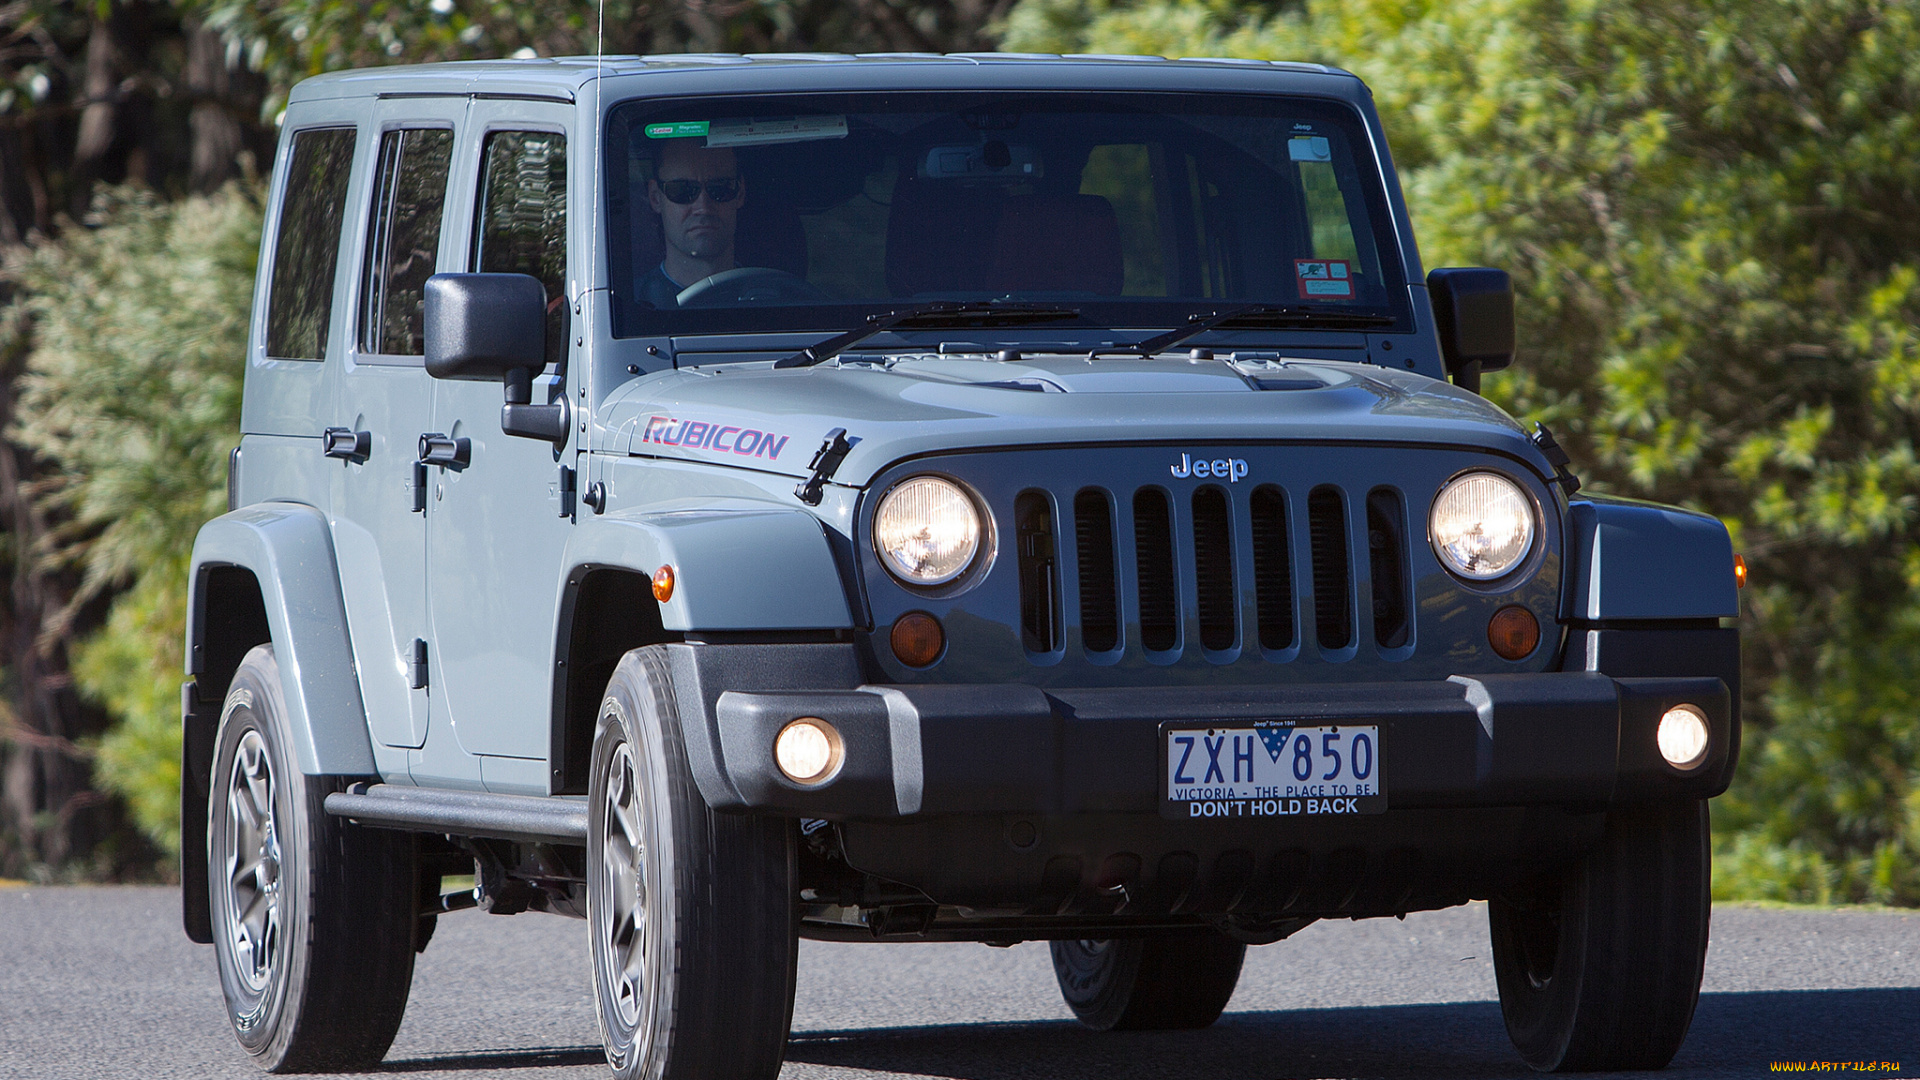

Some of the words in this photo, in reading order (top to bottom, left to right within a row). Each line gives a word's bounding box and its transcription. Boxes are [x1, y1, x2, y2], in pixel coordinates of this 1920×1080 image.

[1293, 123, 1312, 131] Jeep
[642, 416, 790, 460] RUBICON
[1171, 452, 1249, 483] Jeep
[1174, 735, 1254, 784] ZXH
[1292, 733, 1373, 781] 850
[1175, 787, 1236, 800] VICTORIA
[1255, 786, 1279, 798] THE
[1286, 785, 1325, 797] PLACE
[1331, 784, 1348, 796] TO
[1356, 784, 1370, 795] BE
[1190, 800, 1246, 817] DON'T
[1251, 799, 1302, 816] HOLD
[1307, 798, 1358, 814] BACK
